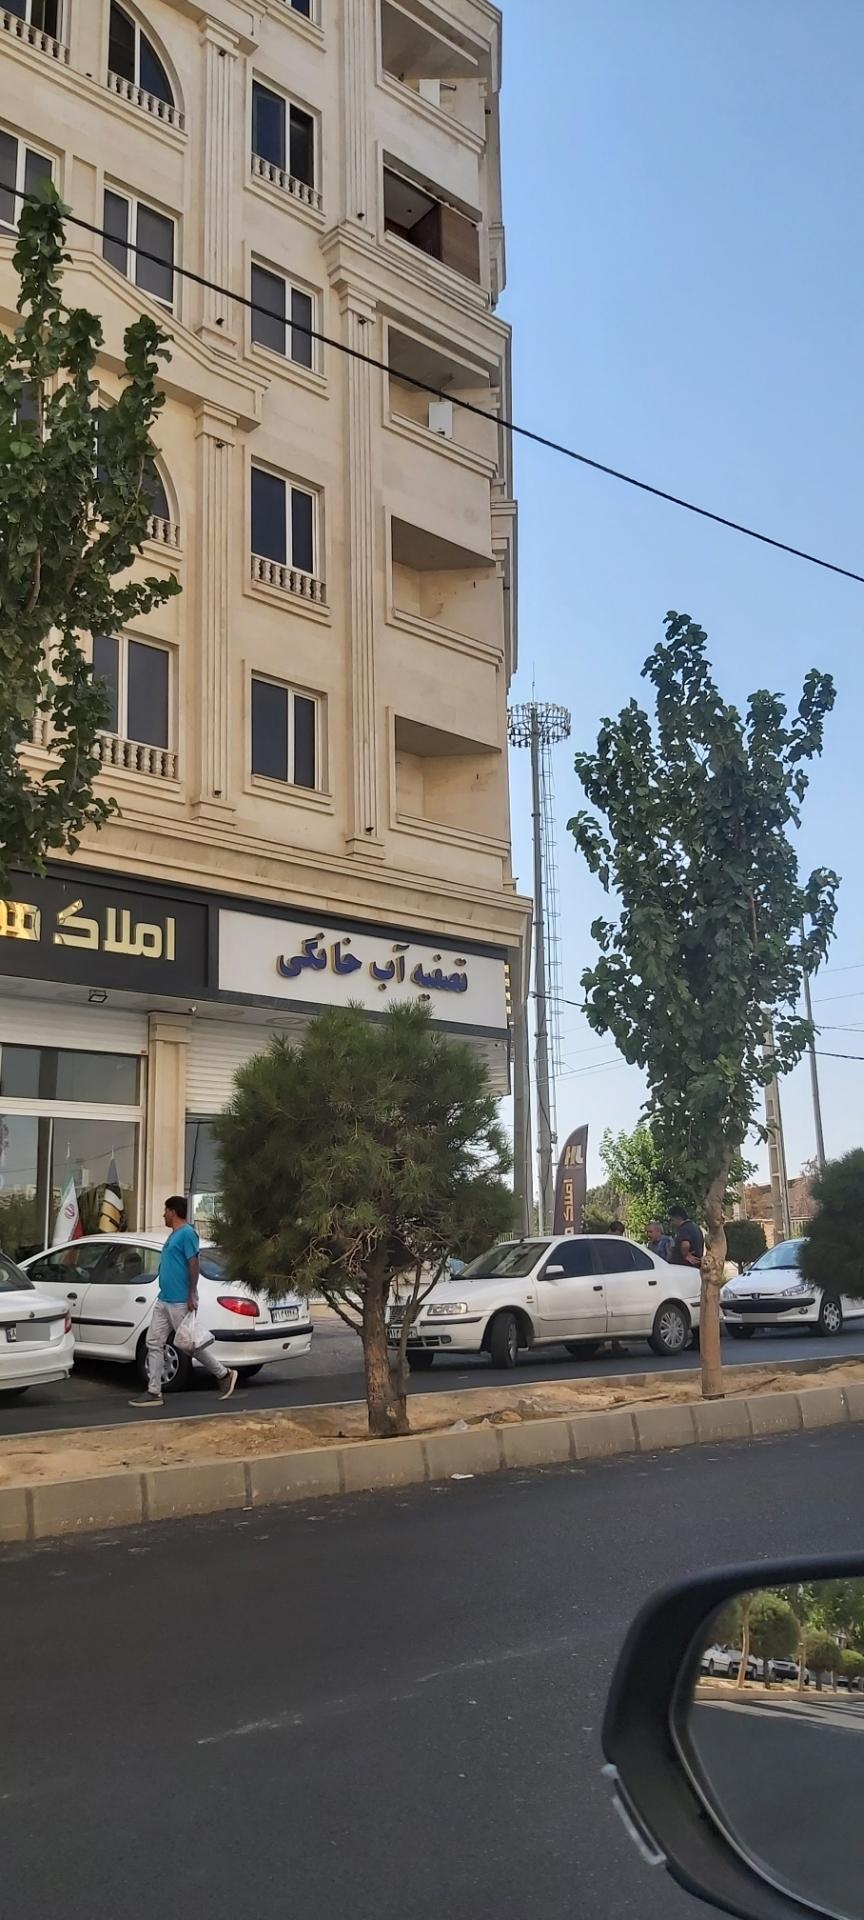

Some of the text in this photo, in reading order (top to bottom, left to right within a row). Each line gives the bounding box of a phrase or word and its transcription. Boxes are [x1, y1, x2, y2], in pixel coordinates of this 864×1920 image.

[52, 899, 176, 962] املاک
[276, 931, 469, 1001] تصفیه آب خانگی
